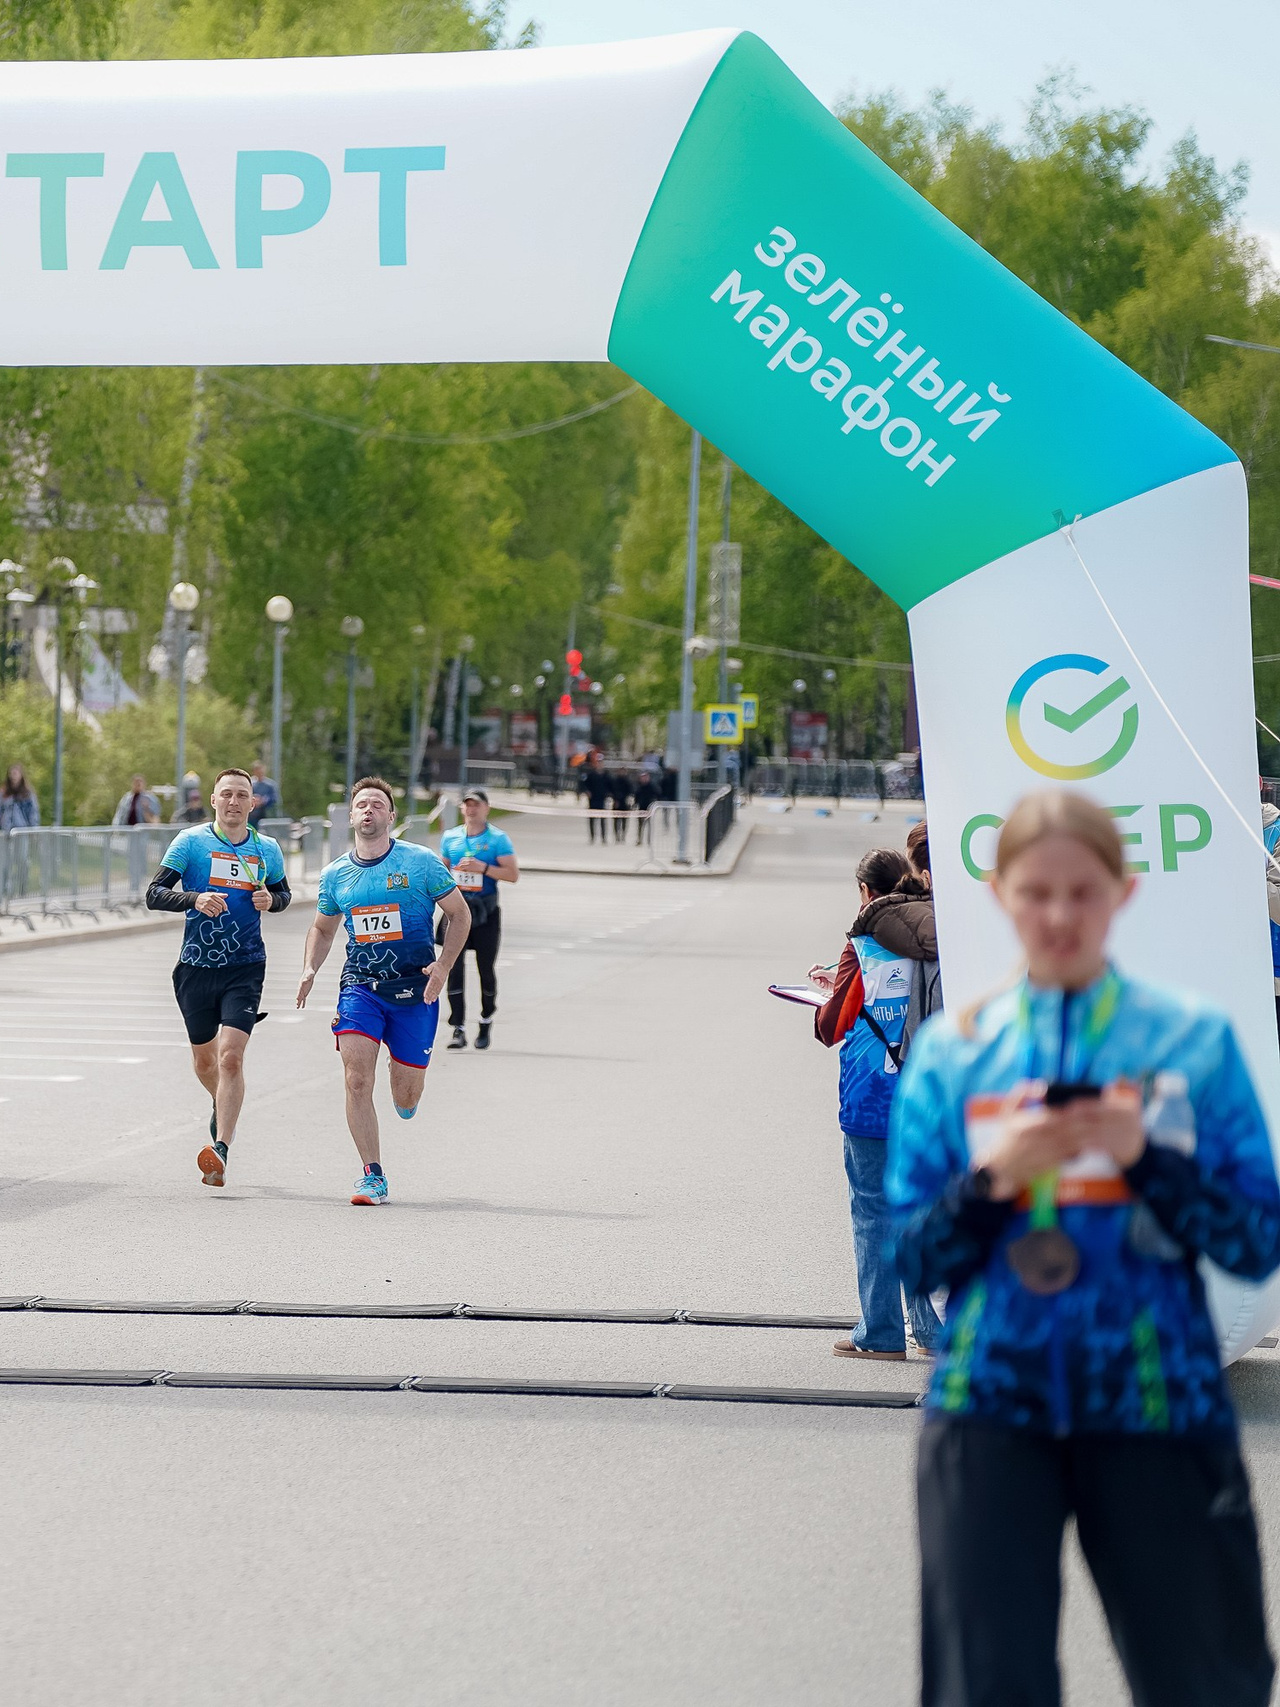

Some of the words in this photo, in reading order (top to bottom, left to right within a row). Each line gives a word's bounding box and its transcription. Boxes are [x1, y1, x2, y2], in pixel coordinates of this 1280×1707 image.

[753, 225, 1013, 443] зелёный
[709, 268, 957, 488] марафон
[230, 863, 239, 877] 5
[960, 803, 1213, 883] СЕР
[362, 915, 391, 932] 176
